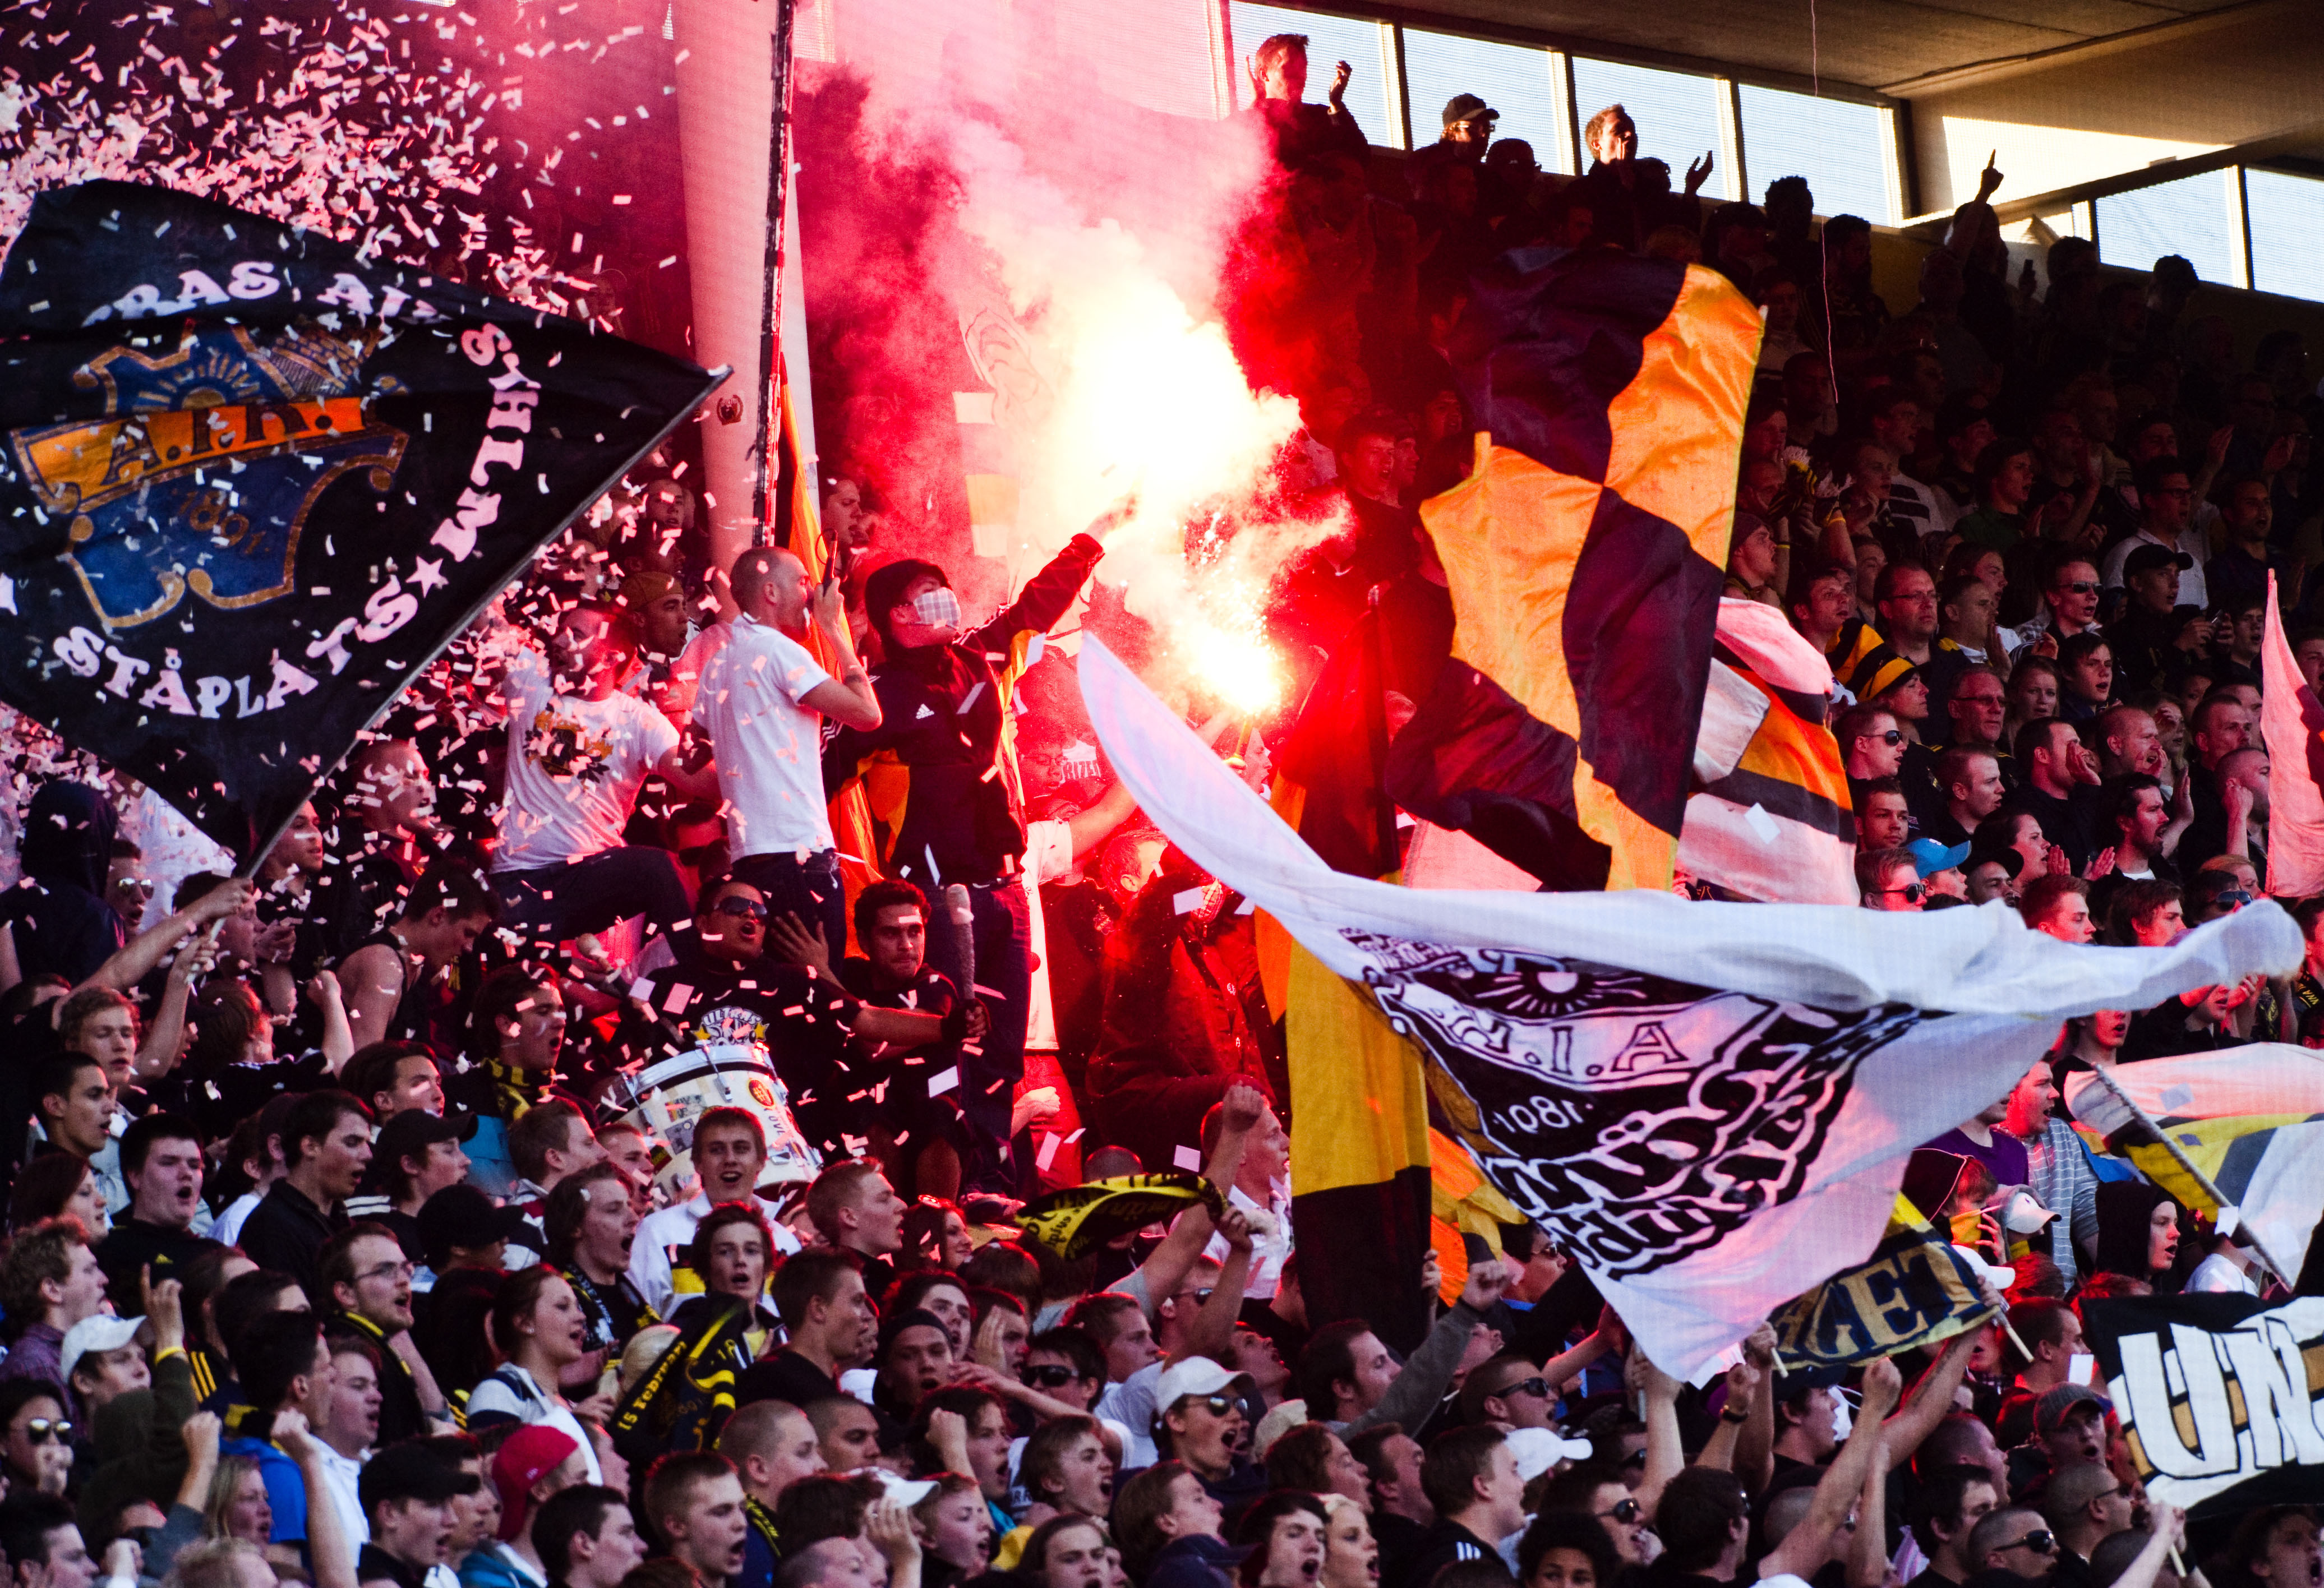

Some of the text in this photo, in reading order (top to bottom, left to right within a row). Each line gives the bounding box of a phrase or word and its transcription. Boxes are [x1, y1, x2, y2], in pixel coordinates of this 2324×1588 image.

[430, 323, 540, 562] STHLM
[54, 575, 418, 718] STÅPLATS
[703, 1007, 761, 1026] ULTRAS
